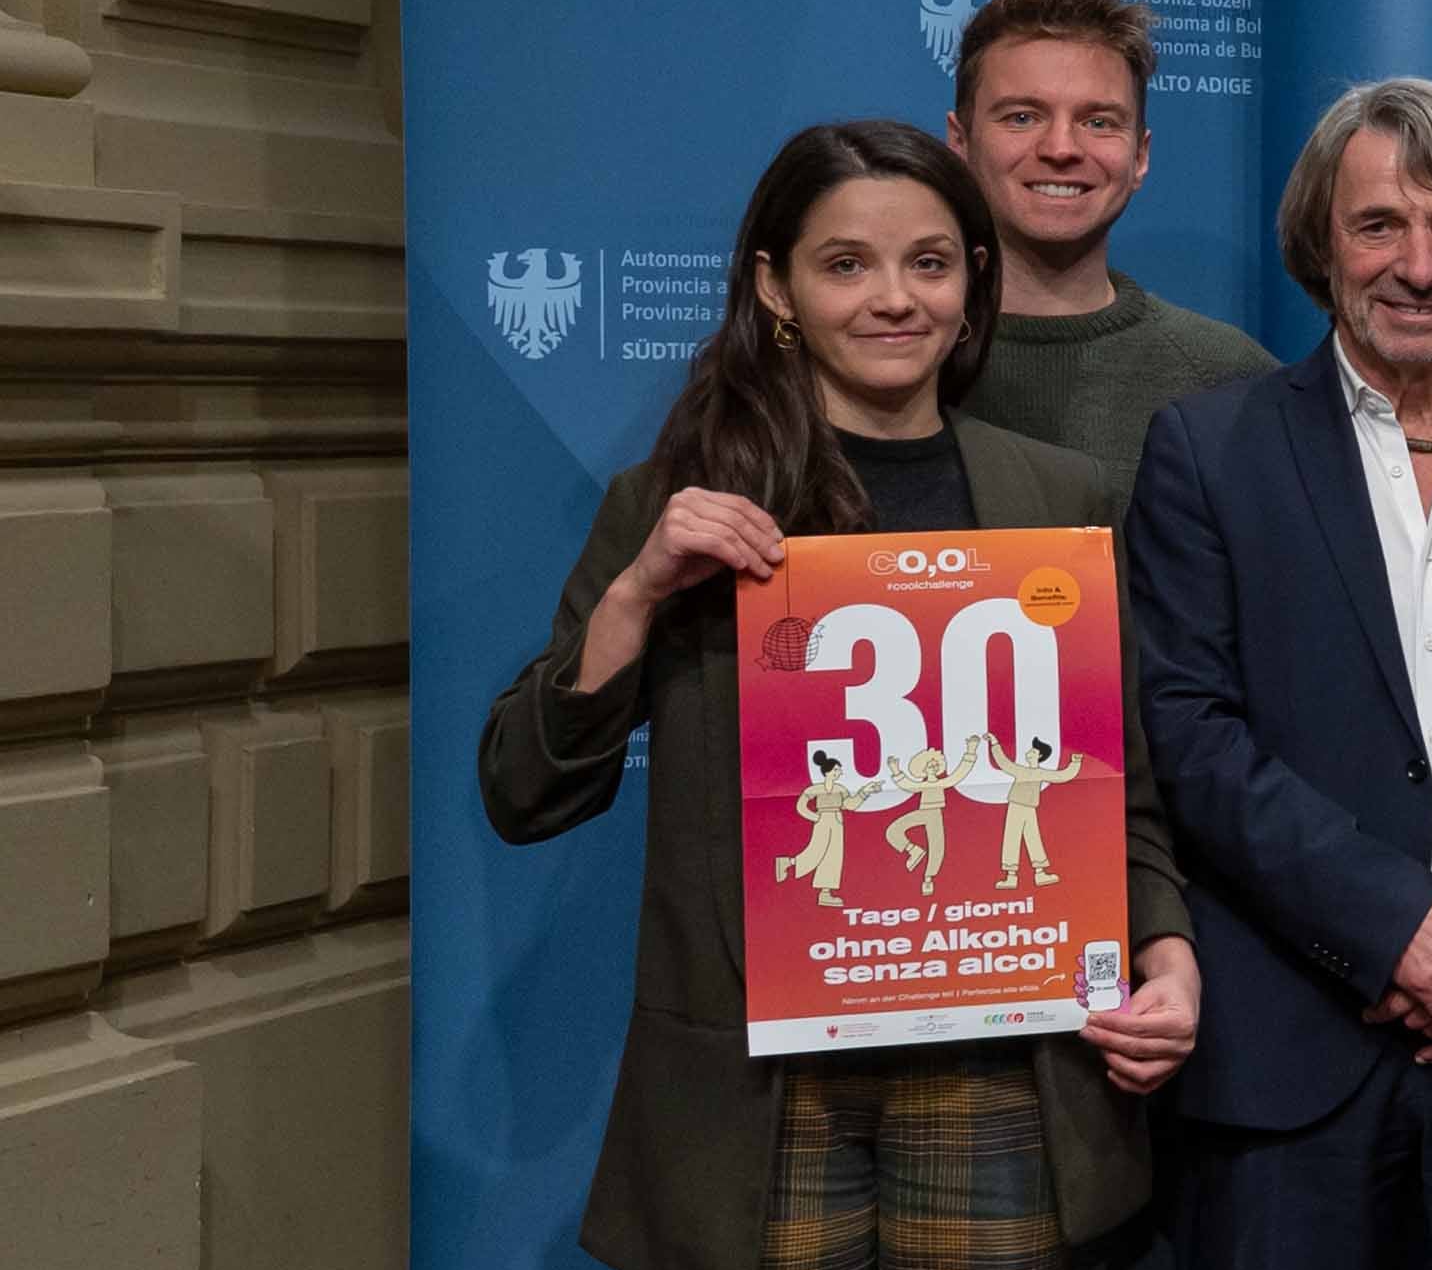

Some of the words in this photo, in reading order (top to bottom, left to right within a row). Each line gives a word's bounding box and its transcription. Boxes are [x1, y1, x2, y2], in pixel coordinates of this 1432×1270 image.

[1196, 76, 1251, 94] ADIGE
[621, 250, 721, 267] Autonome
[623, 277, 710, 294] Provincia
[623, 304, 710, 321] Provinzia
[804, 598, 1062, 813] 30
[843, 909, 920, 926] Tage
[945, 897, 1033, 921] giorni
[810, 937, 912, 959] ohne
[922, 922, 1067, 955] Alkohol
[824, 960, 946, 984] senza
[958, 948, 1054, 975] alcol
